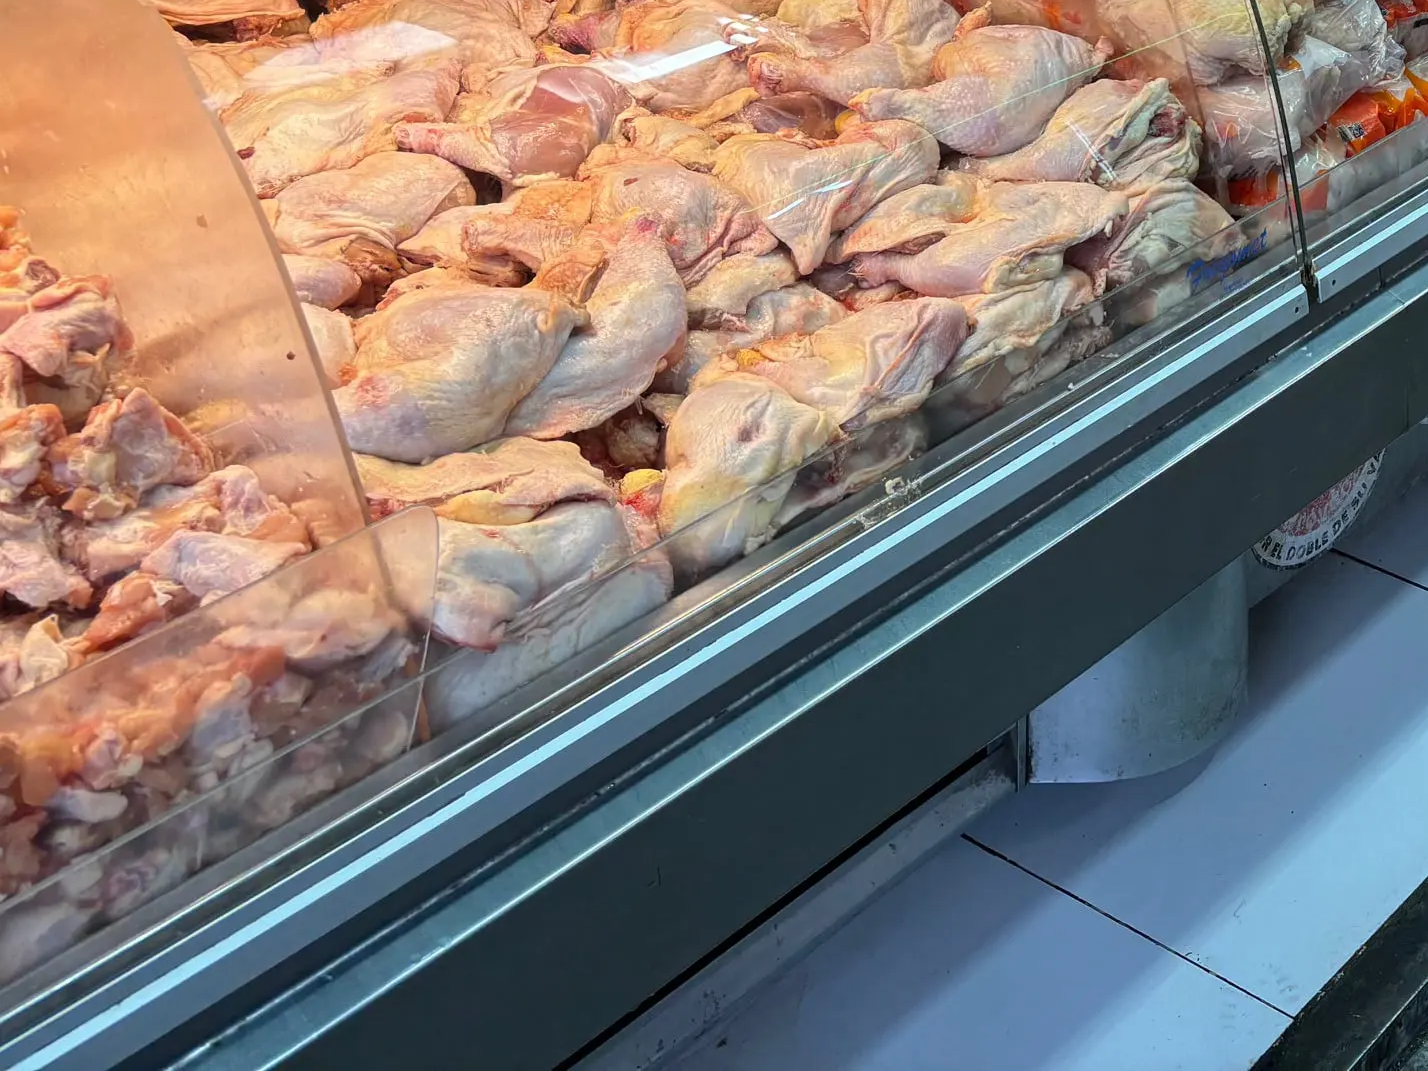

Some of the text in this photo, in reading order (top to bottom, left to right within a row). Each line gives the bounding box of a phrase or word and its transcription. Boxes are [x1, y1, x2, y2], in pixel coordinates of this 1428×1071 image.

[1286, 530, 1329, 561] DOBLE
[1332, 510, 1350, 535] DE
[1351, 482, 1368, 511] SU
